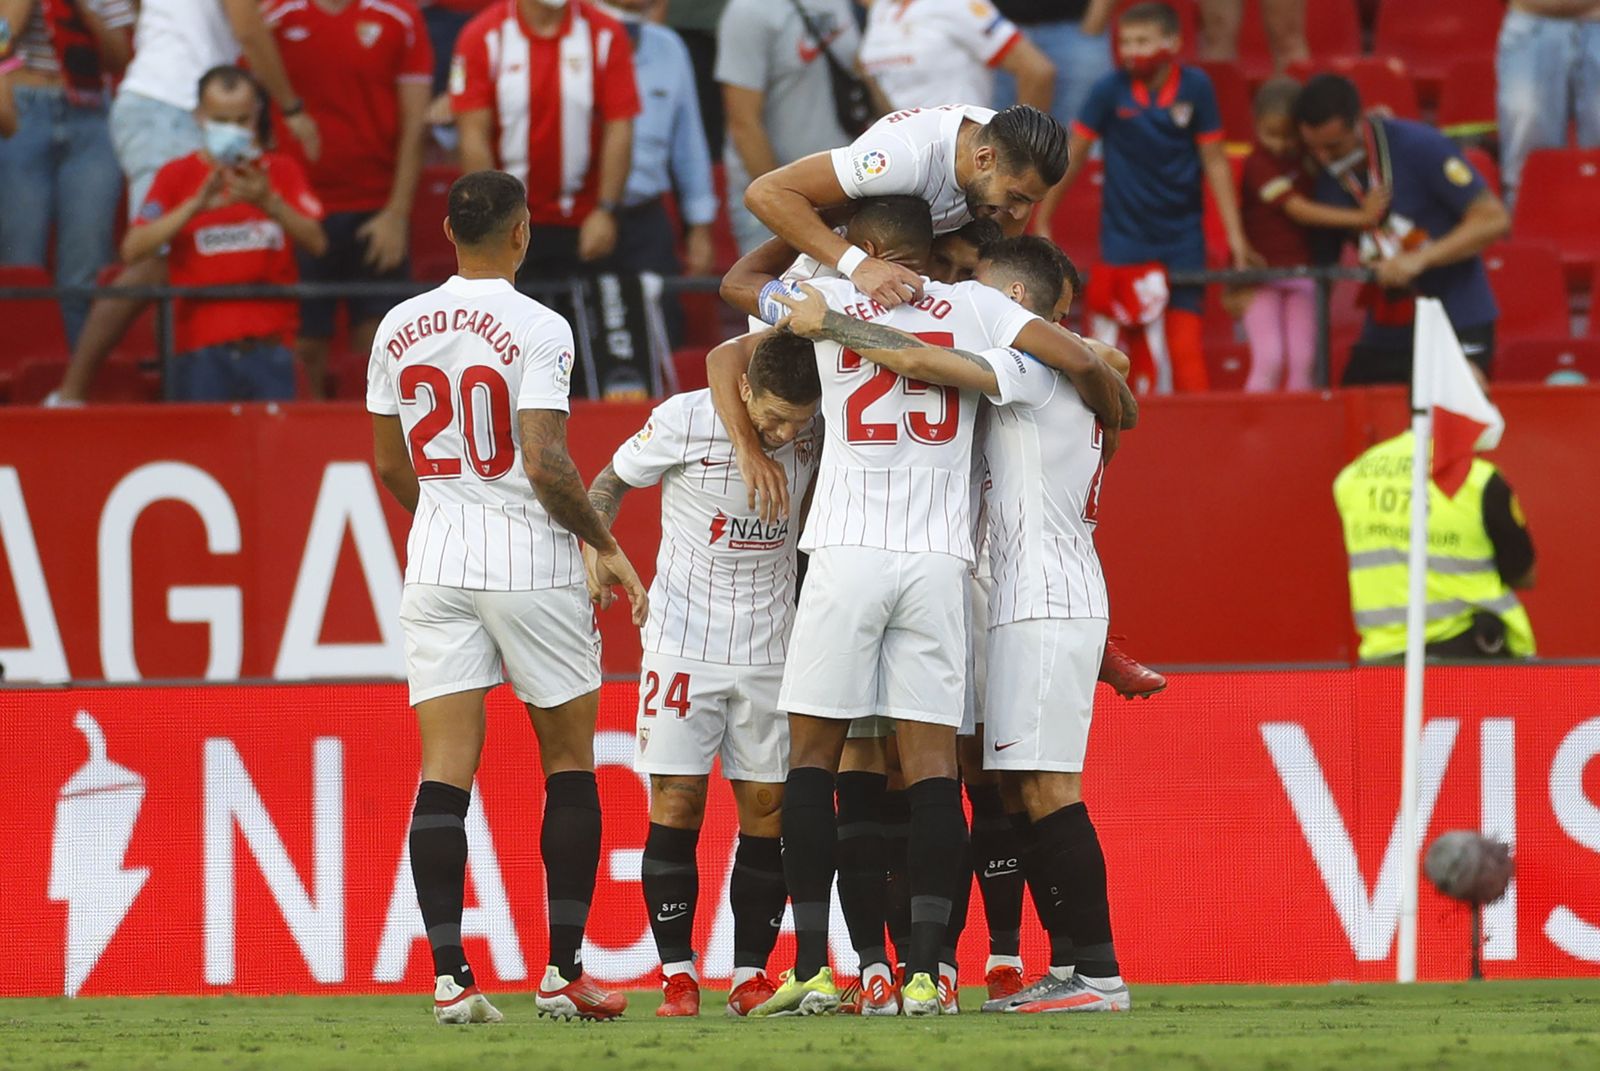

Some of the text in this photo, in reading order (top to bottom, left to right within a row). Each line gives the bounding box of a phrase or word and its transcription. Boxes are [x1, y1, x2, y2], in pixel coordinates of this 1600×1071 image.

[844, 294, 952, 321] FERDO
[387, 309, 520, 366] DIEGO CARLOS
[1008, 350, 1028, 375] oline
[836, 331, 961, 446] 25
[397, 364, 515, 481] 20
[729, 516, 789, 540] NAGA
[642, 670, 692, 719] 24
[989, 858, 1018, 869] SFC
[662, 902, 688, 912] SFC
